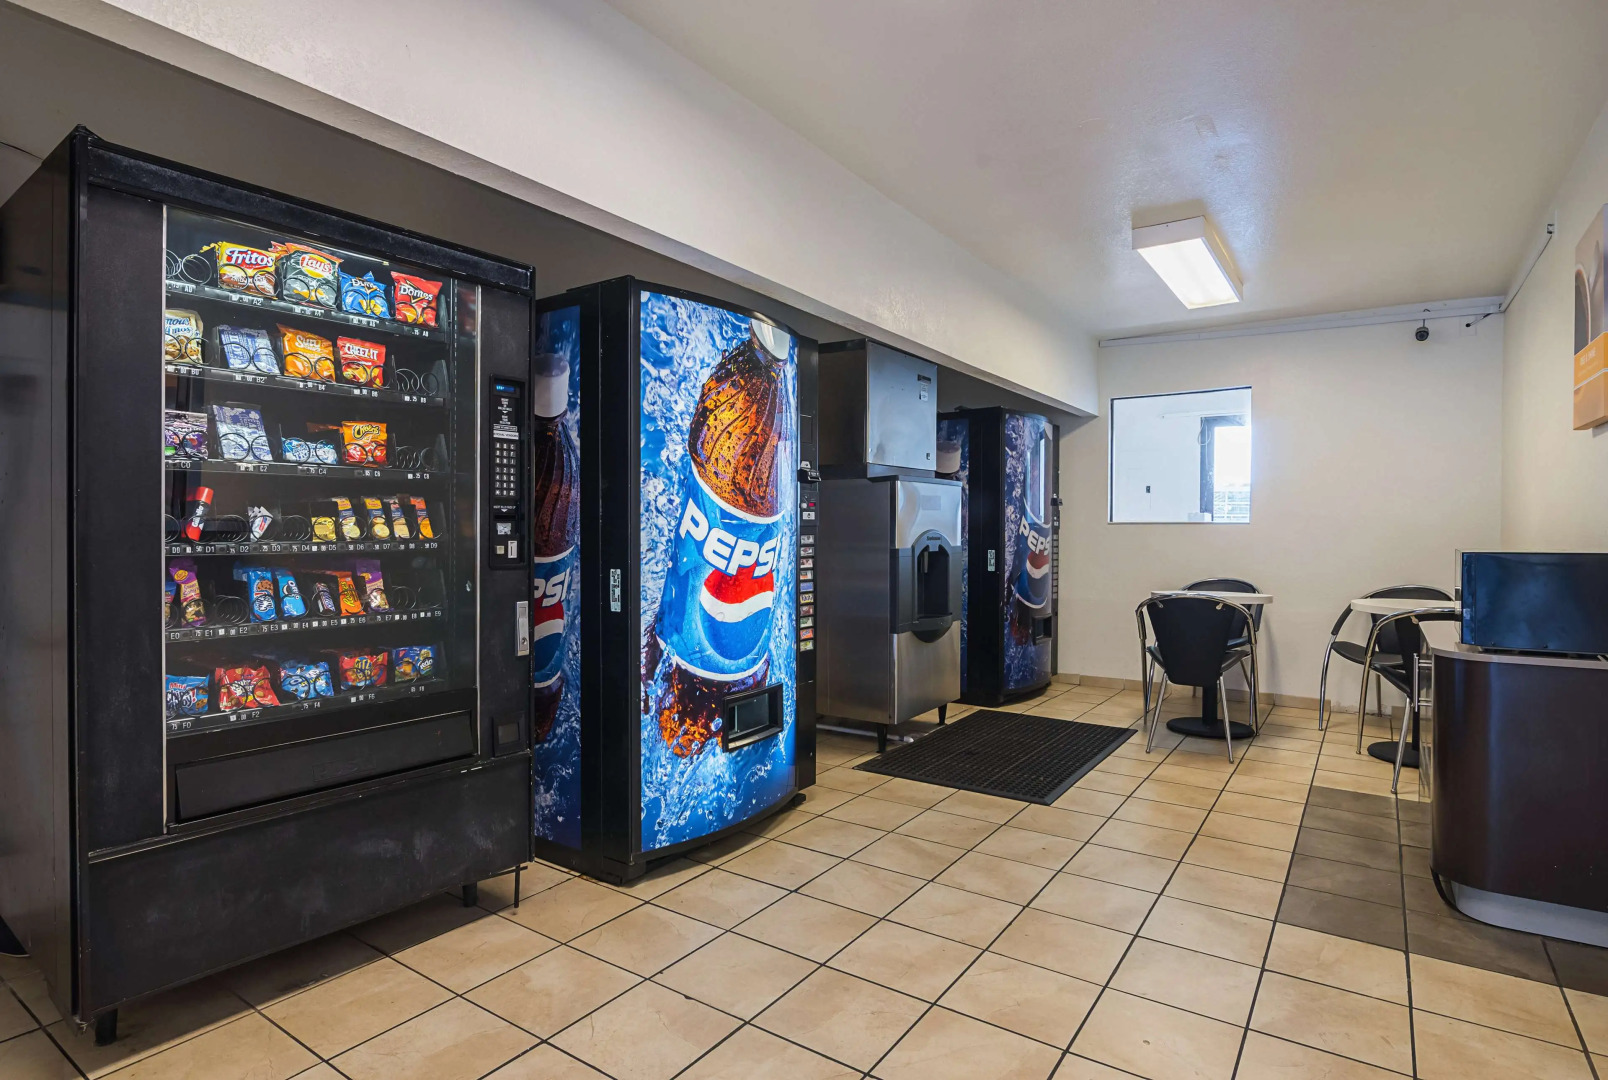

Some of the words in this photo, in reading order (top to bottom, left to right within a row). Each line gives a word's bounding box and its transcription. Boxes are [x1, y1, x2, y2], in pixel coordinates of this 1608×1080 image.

[225, 248, 275, 268] Fritos
[400, 286, 434, 301] Doritos
[252, 298, 262, 306] A2
[678, 498, 782, 579] PEPSI
[1019, 515, 1050, 555] PEPS
[204, 629, 213, 637] E1
[251, 710, 260, 718] F2
